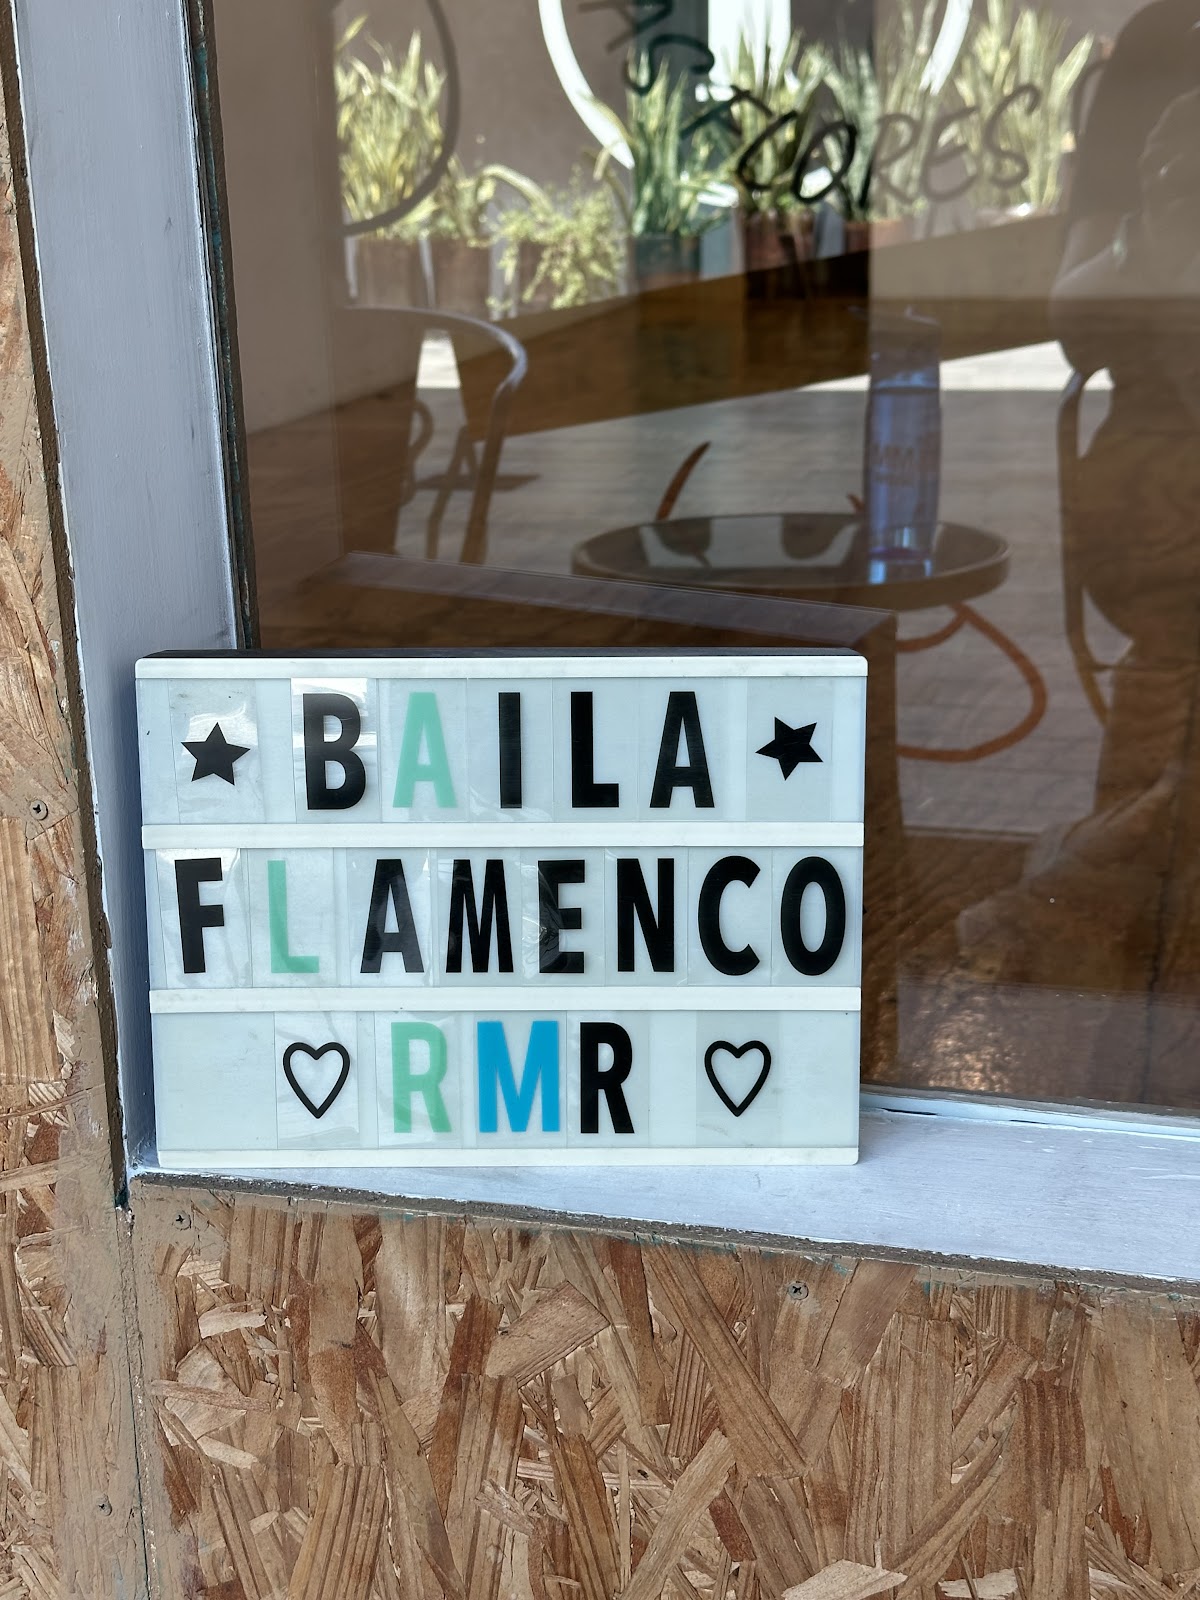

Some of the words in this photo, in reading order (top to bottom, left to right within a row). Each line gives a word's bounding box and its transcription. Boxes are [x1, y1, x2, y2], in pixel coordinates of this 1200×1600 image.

[303, 691, 716, 810] BAILA
[174, 855, 847, 977] FLAMENCO
[391, 1018, 635, 1134] RMR
